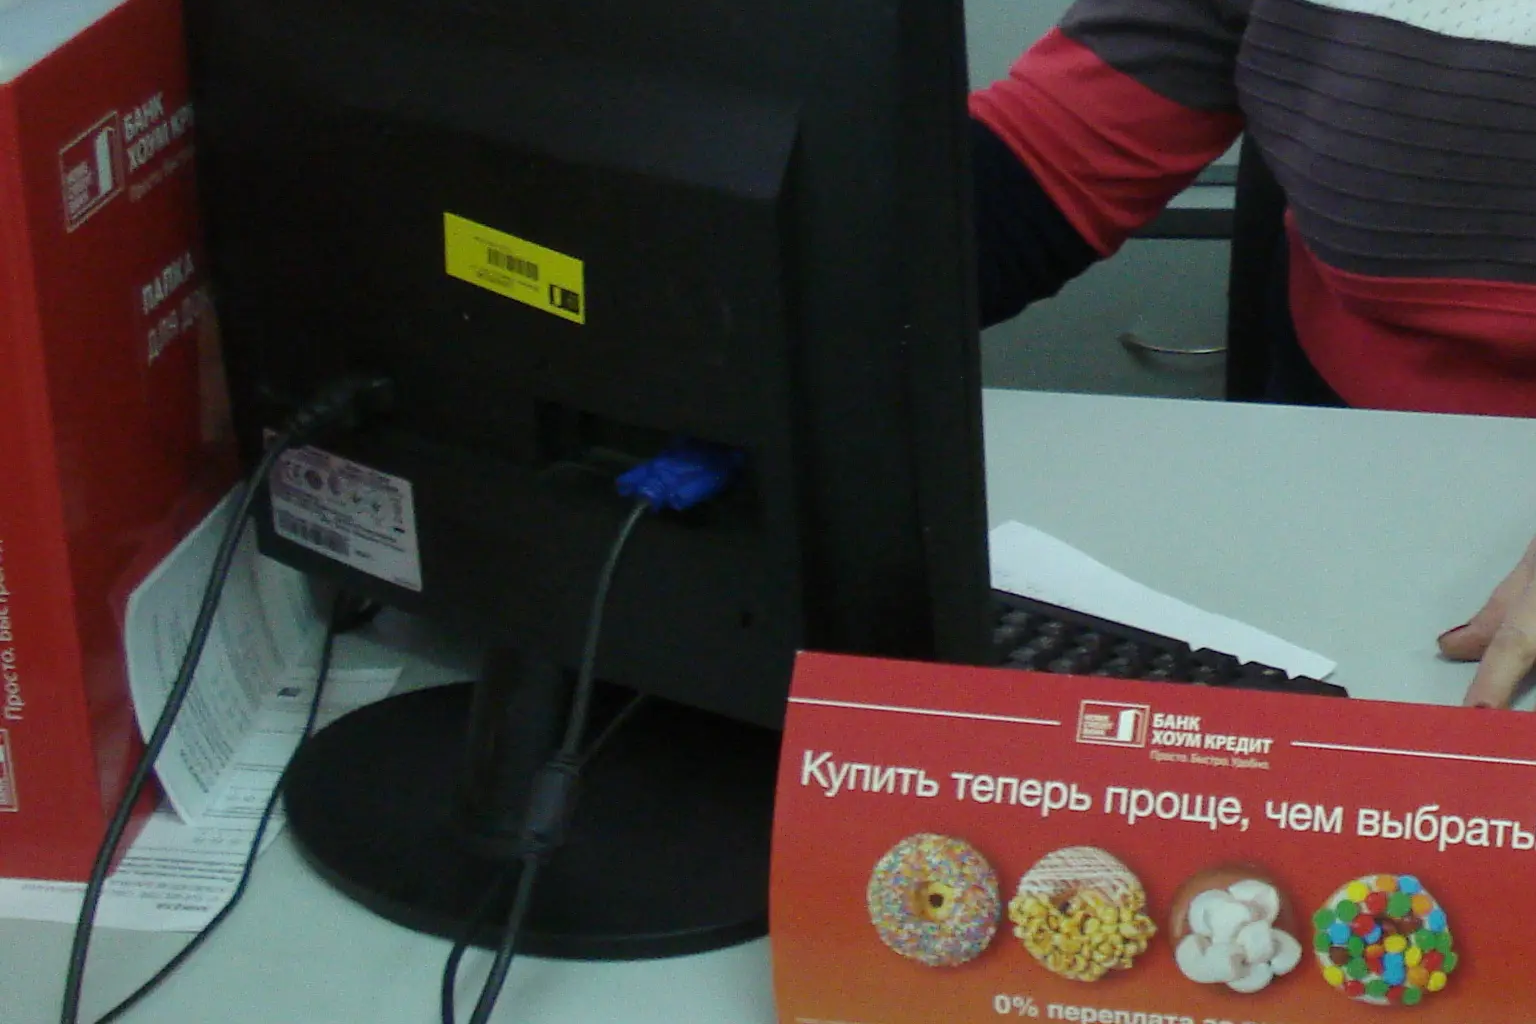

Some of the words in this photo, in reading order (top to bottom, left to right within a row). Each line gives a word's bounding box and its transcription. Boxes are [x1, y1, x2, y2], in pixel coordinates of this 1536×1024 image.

[123, 91, 164, 142] БАНК
[1152, 713, 1201, 731] БАНК
[1151, 729, 1202, 748] ХОУМ
[1203, 733, 1273, 755] КРЕДИТ
[800, 750, 940, 797] Купить
[950, 772, 1093, 817] теперь
[1103, 785, 1251, 832] проще,
[1264, 799, 1344, 834] чем
[992, 993, 1040, 1018] 0%
